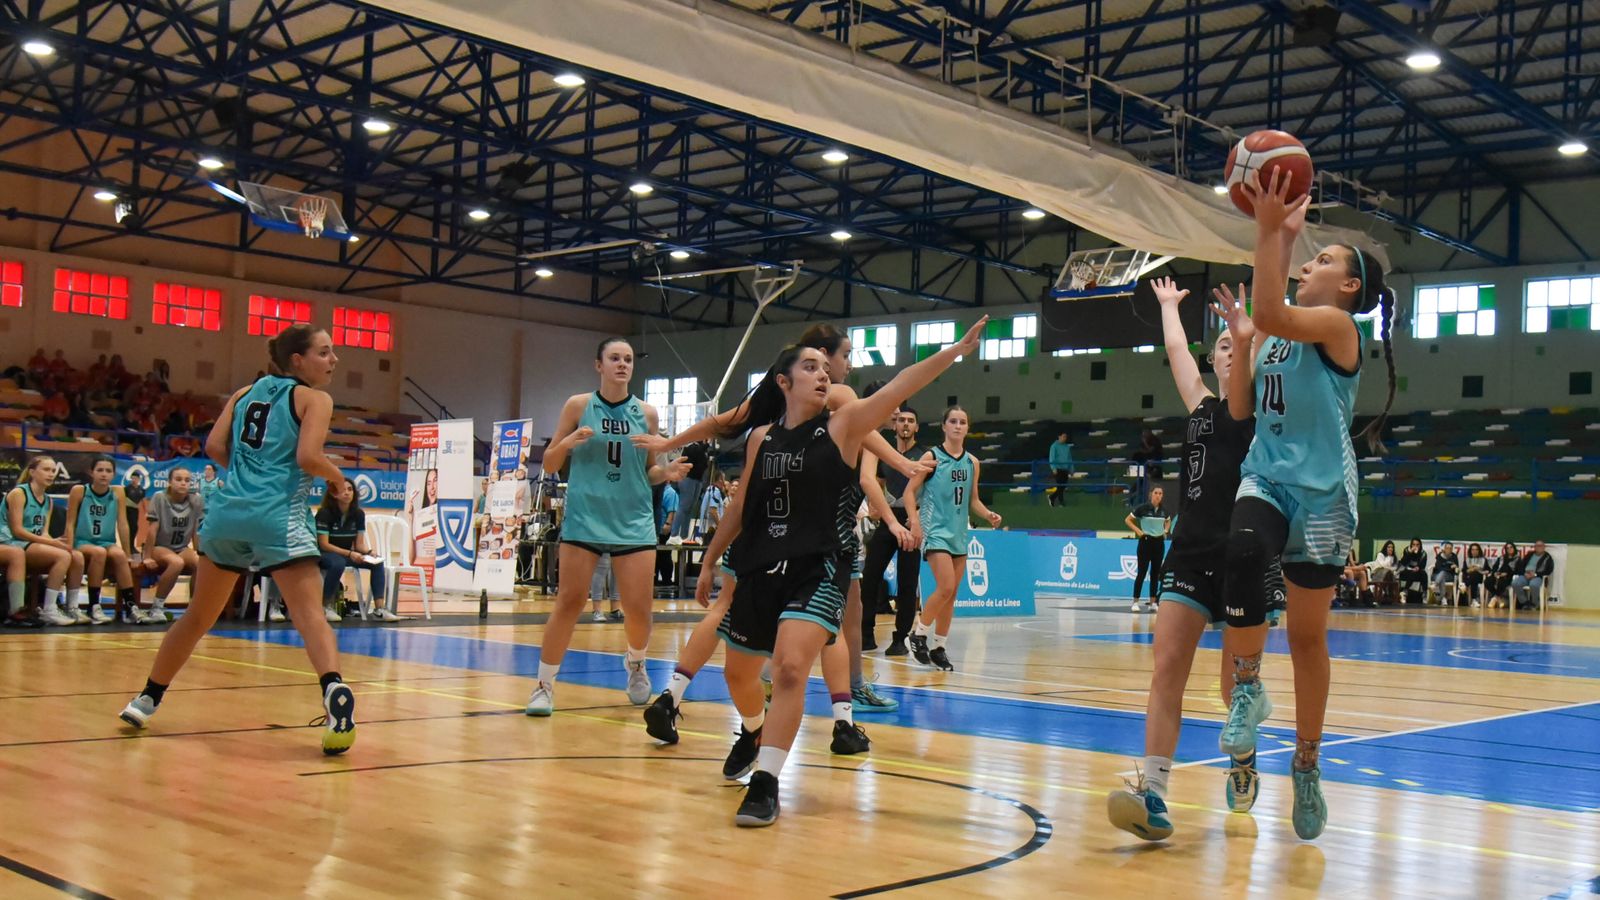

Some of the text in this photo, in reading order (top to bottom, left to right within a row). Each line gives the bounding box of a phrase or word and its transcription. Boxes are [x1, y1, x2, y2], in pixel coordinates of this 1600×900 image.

[1261, 373, 1286, 416] 14
[240, 400, 272, 451] 8
[607, 440, 622, 468] 4
[954, 486, 964, 506] 13
[92, 520, 102, 537] 5
[1034, 579, 1070, 588] Ayuntamiento
[1176, 581, 1195, 592] vive
[986, 598, 993, 607] de
[995, 599, 1003, 607] La
[1003, 598, 1021, 607] Línea
[1230, 607, 1245, 617] NBA
[730, 630, 748, 642] vive
